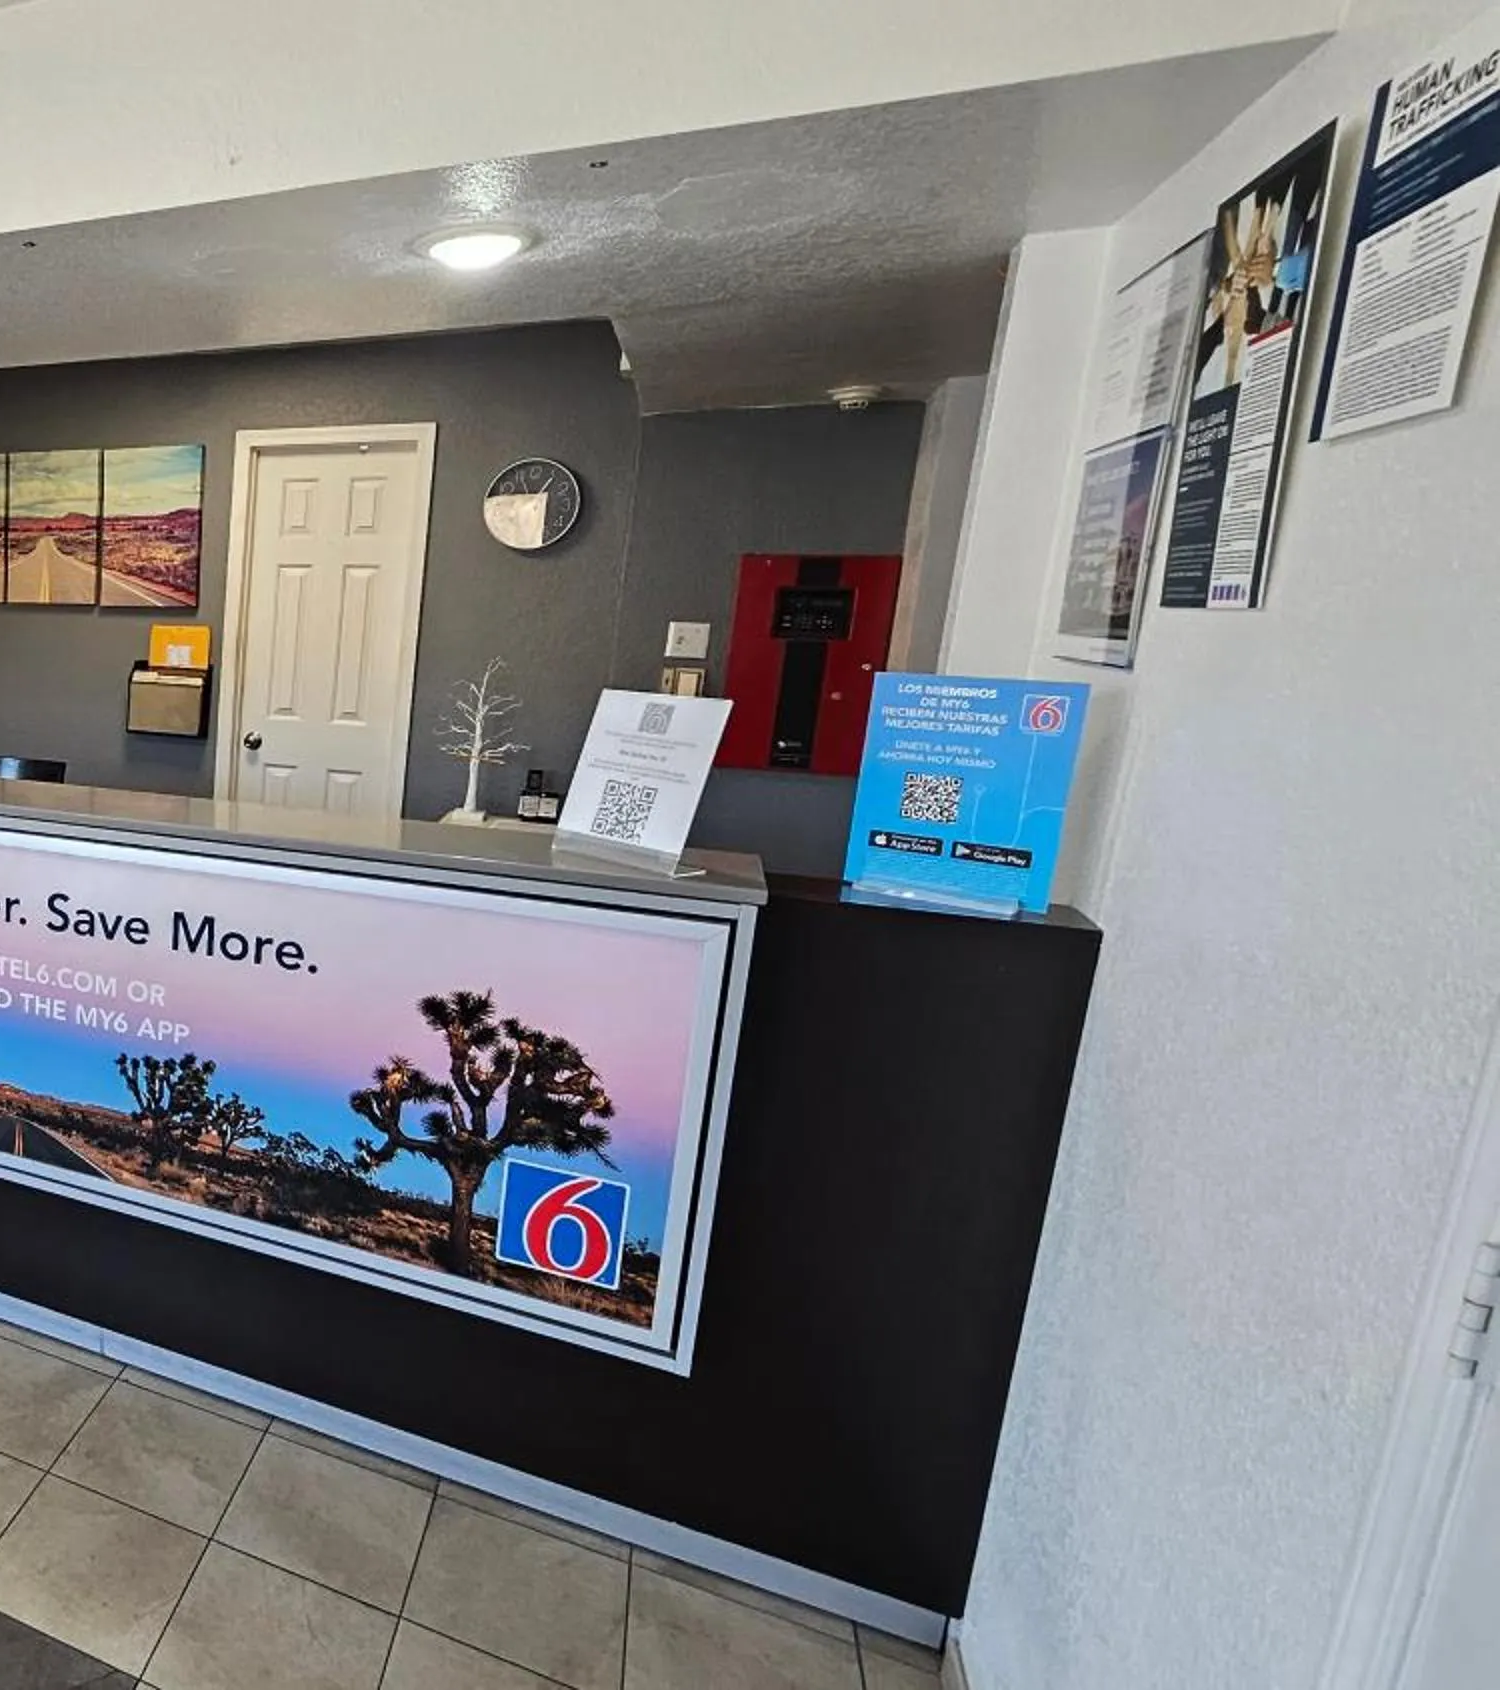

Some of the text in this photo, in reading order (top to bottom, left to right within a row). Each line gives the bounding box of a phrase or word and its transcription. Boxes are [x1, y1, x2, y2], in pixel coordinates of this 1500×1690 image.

[1389, 49, 1500, 140] TRAFFICKING
[1392, 57, 1455, 114] HUMAN
[898, 683, 997, 699] LOS MIEMBROS
[920, 697, 971, 709] DE MY6
[881, 706, 1008, 726] RECIBEN NUESTRAS
[1029, 696, 1062, 734] 6
[884, 718, 999, 737] MEJORES TARIFAS
[927, 755, 953, 766] HOY
[889, 840, 937, 853] App Store
[973, 852, 1027, 867] Google Play
[45, 892, 150, 945] Save
[171, 911, 319, 975] More.
[127, 980, 166, 1007] OR
[20, 992, 67, 1022] THE
[75, 1003, 128, 1034] MY6
[137, 1016, 190, 1045] APP
[523, 1176, 612, 1281] 6
